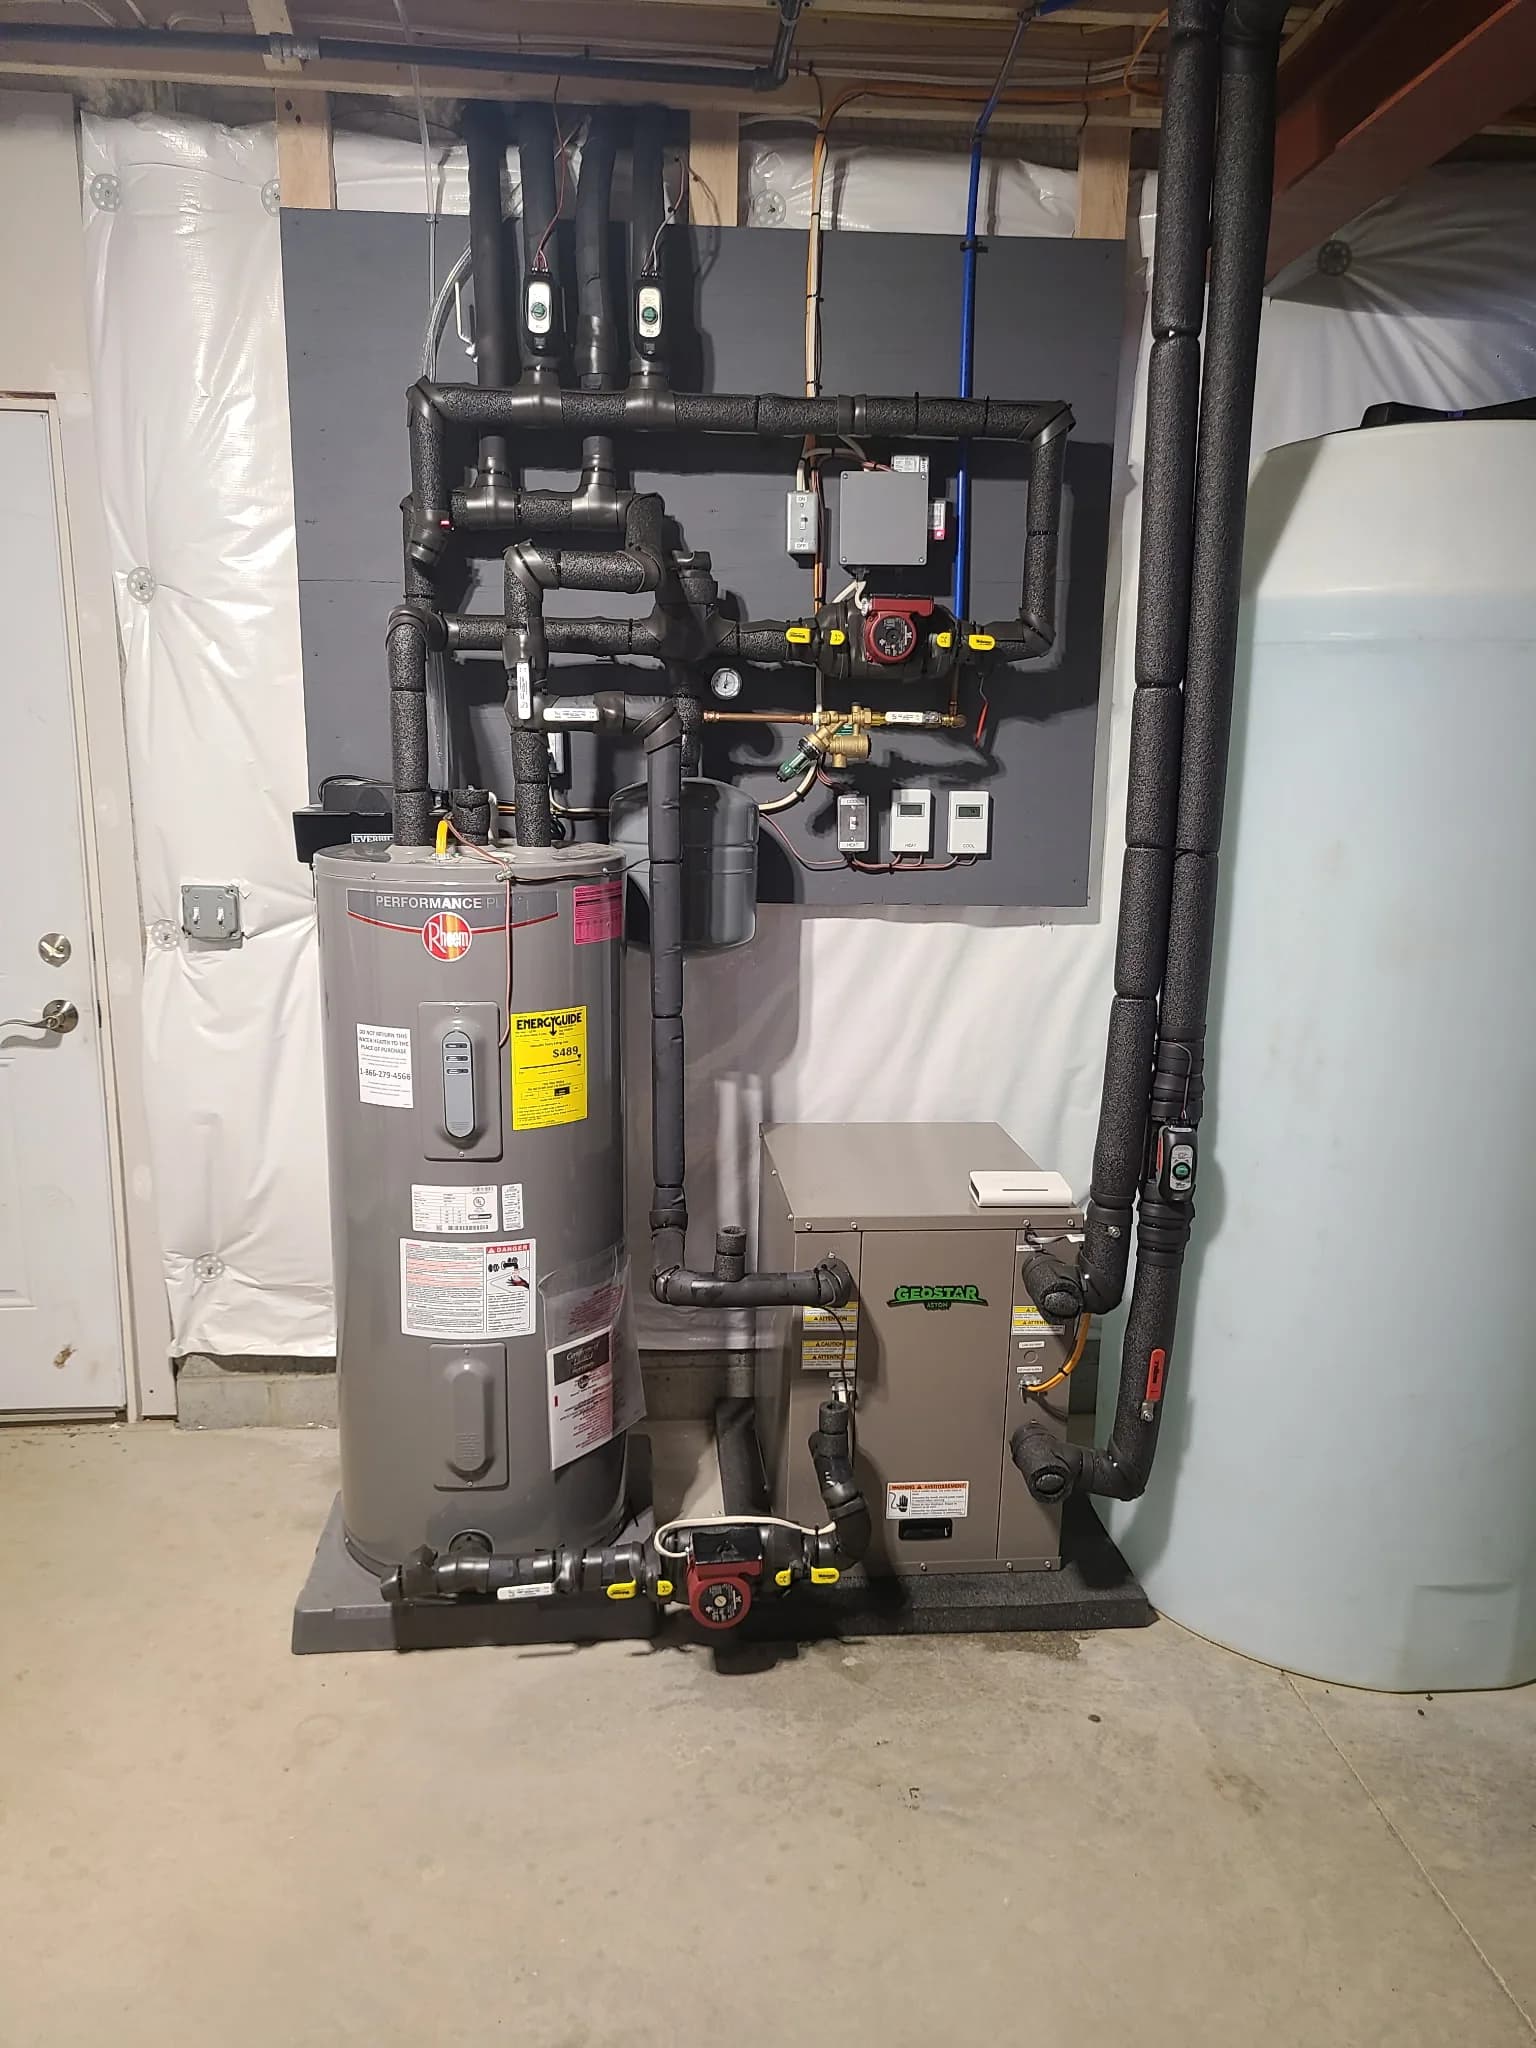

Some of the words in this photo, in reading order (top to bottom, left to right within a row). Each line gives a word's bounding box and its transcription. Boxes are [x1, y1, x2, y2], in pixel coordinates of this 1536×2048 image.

[375, 895, 482, 910] PERFORMANCE
[427, 913, 469, 954] Rheem
[496, 1244, 528, 1253] DANGER
[895, 1285, 978, 1302] GEOSTAR
